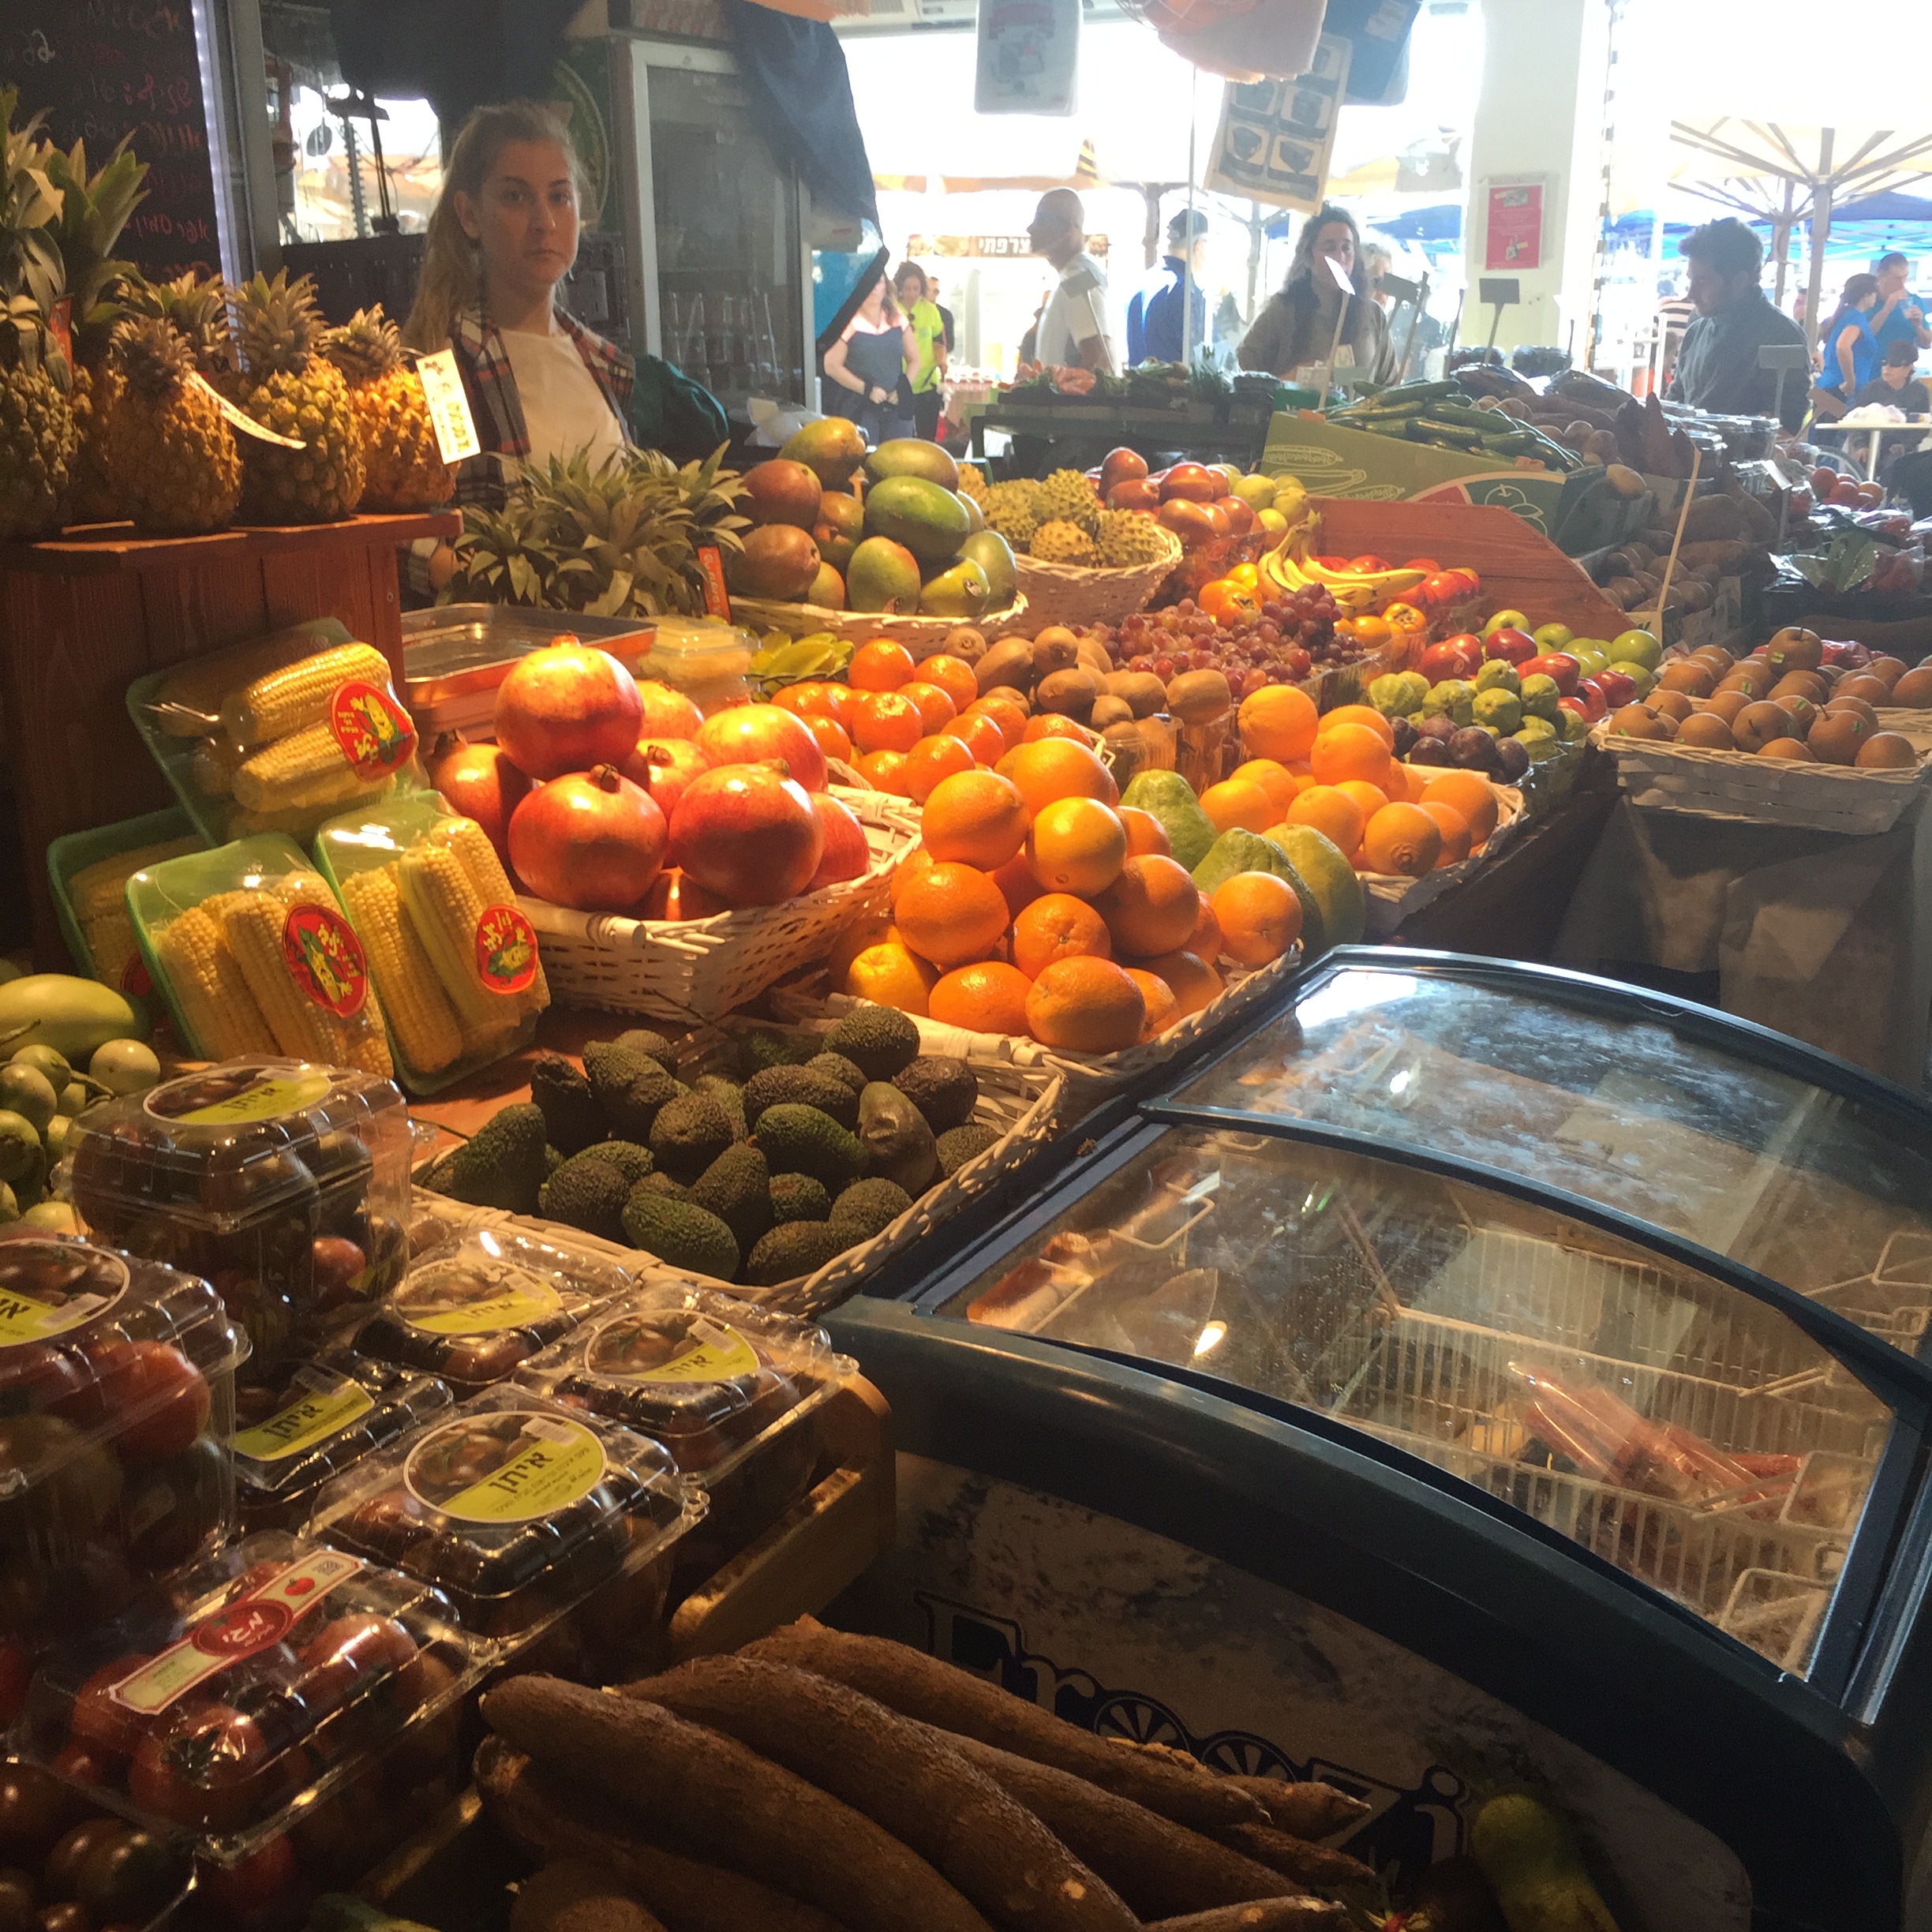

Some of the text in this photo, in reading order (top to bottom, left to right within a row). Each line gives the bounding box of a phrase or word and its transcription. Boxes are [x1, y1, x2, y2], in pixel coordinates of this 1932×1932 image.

[664, 1354, 713, 1376] אית
[262, 1403, 324, 1440] איתן
[488, 1450, 554, 1495] איתן
